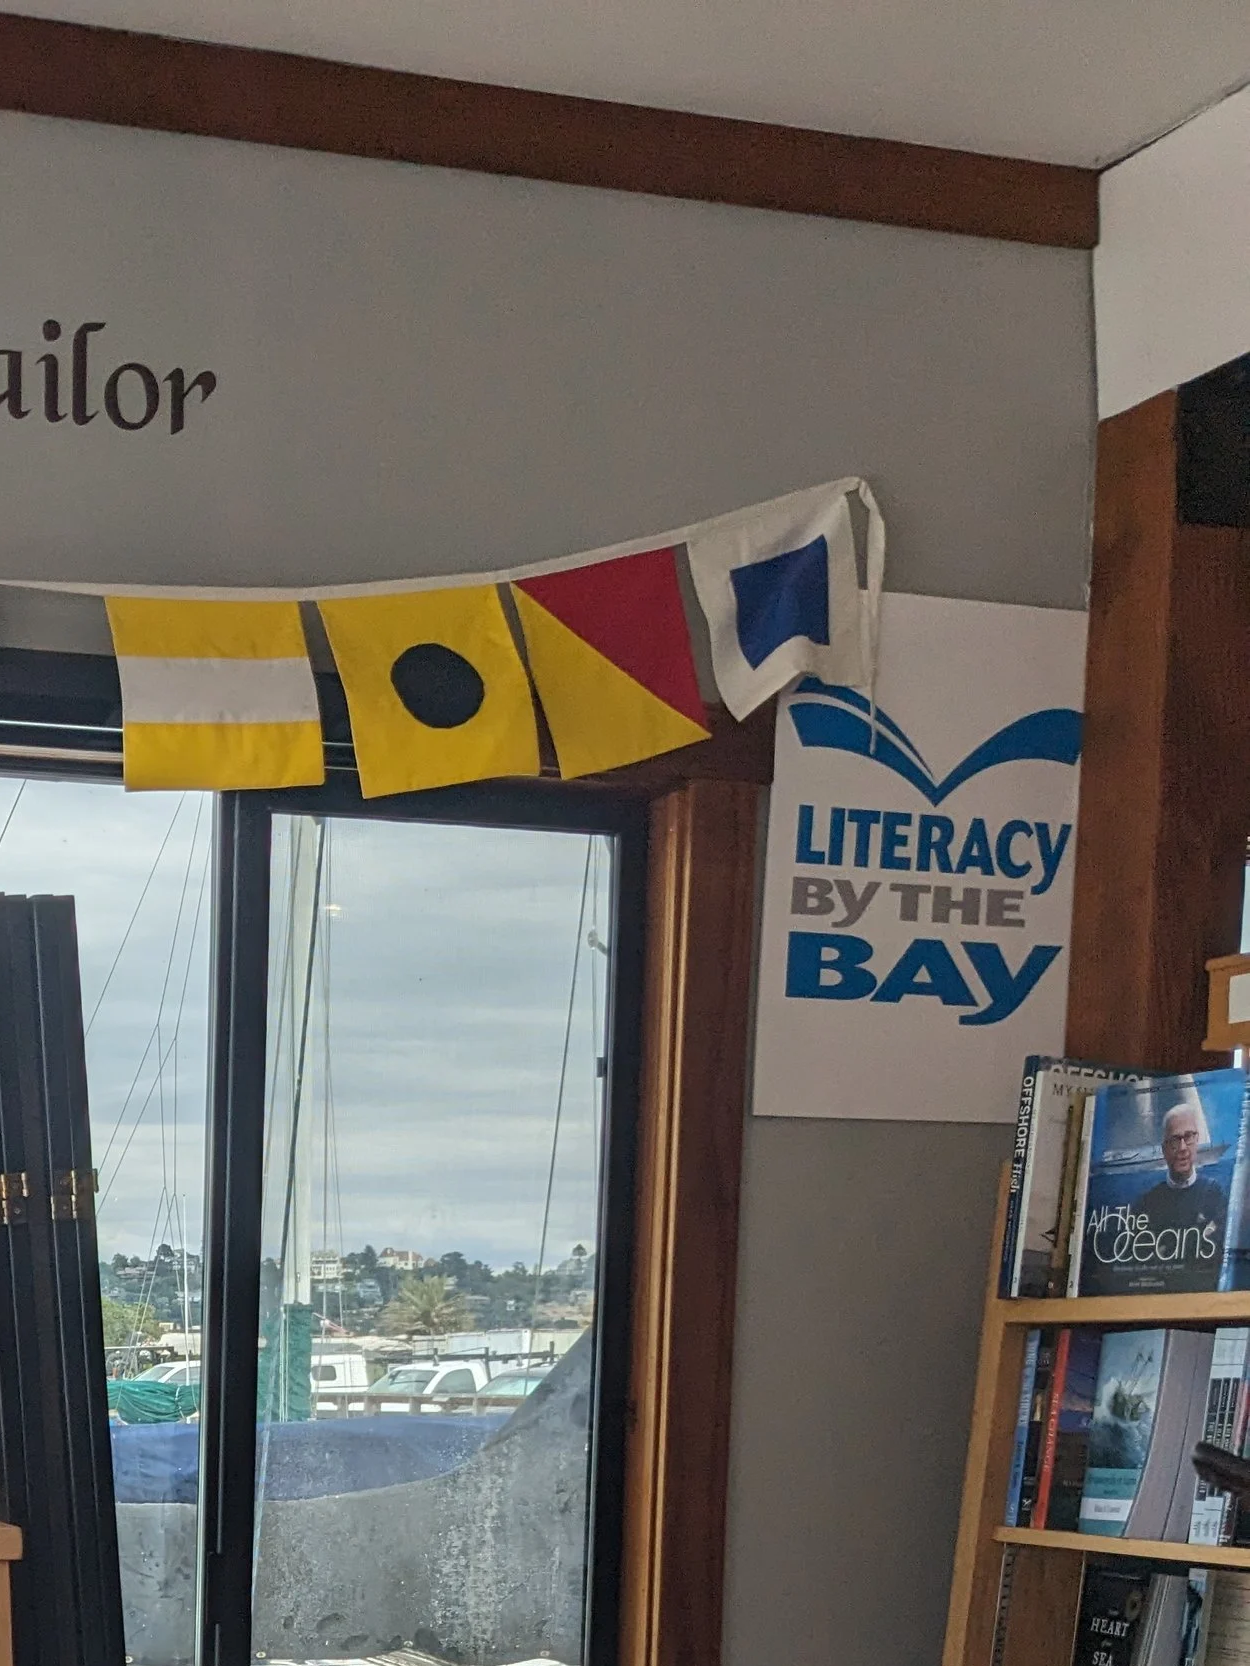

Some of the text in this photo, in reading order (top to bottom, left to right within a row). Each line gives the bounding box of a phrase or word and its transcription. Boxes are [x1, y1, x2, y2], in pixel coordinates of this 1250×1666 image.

[795, 804, 1072, 896] LITERACY
[889, 883, 1026, 928] THE
[1015, 1076, 1034, 1159] OFFSHORE
[1087, 1204, 1149, 1234] All The
[1093, 1213, 1216, 1264] Oceans
[1091, 1618, 1130, 1637] HEART
